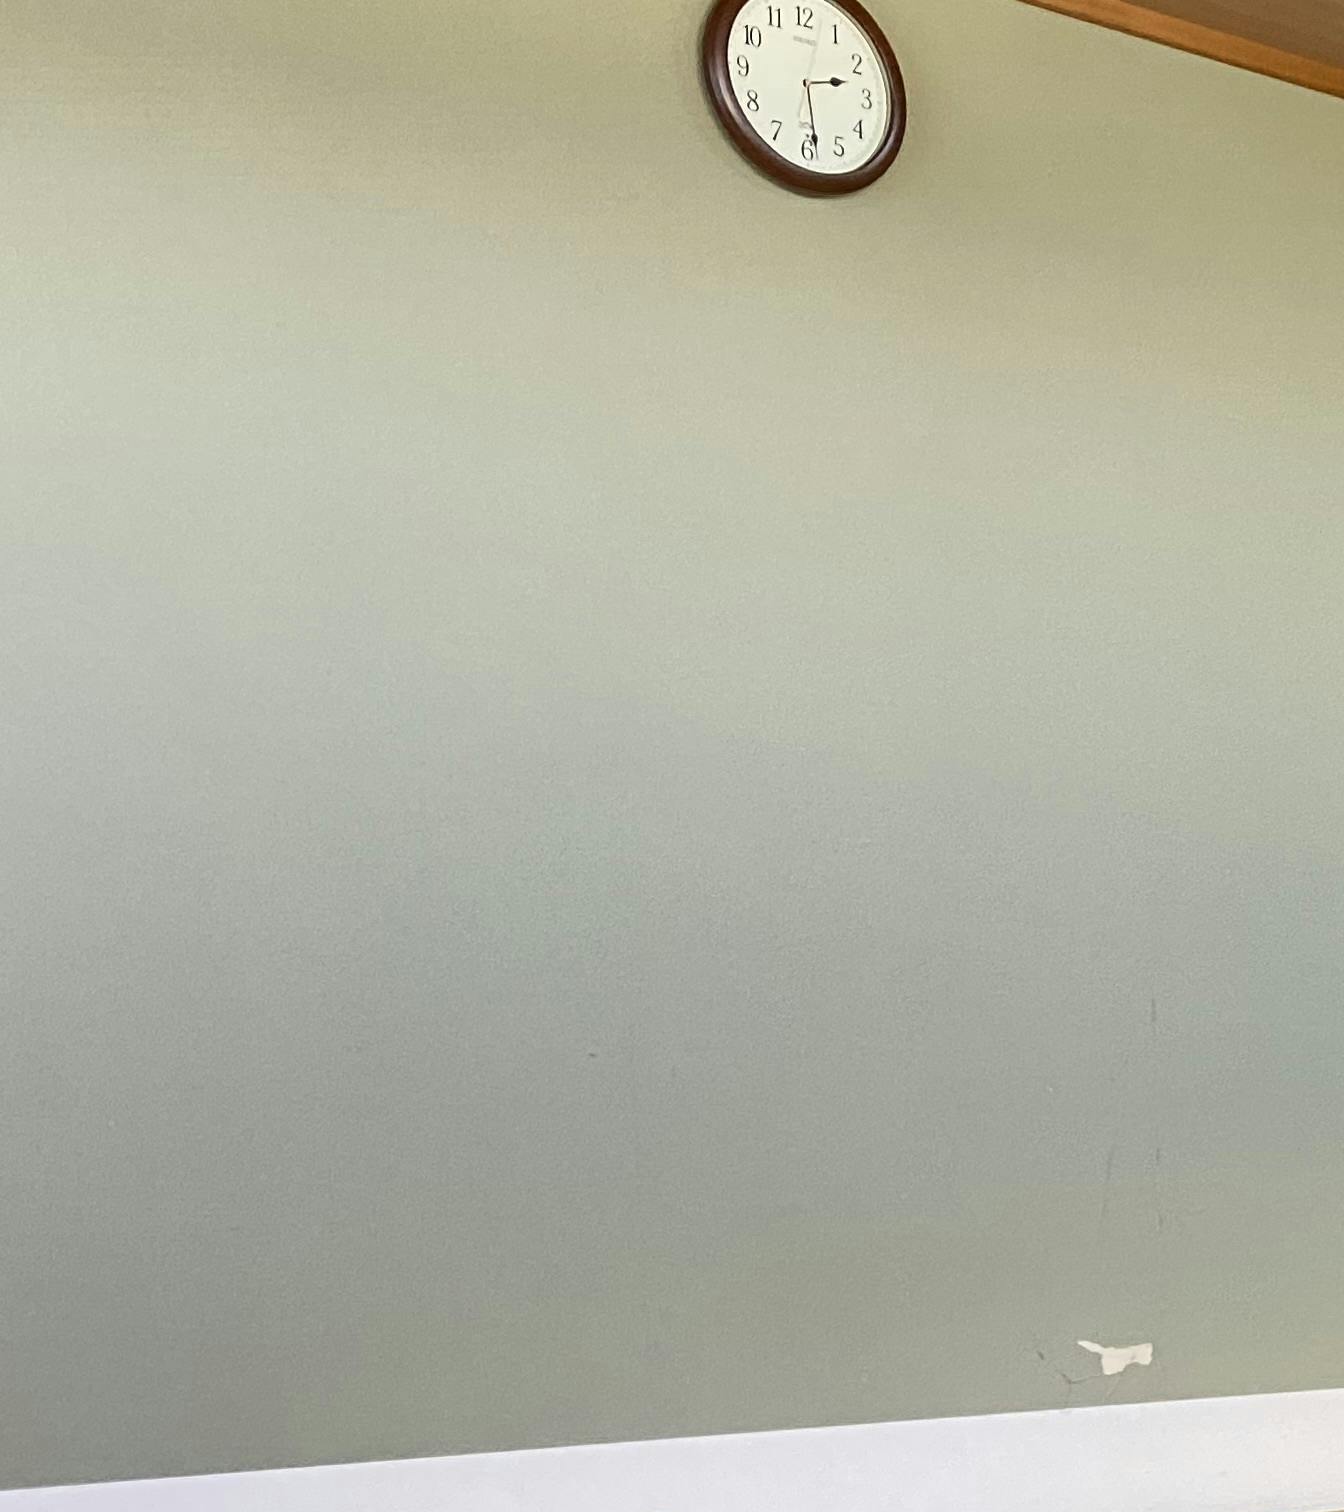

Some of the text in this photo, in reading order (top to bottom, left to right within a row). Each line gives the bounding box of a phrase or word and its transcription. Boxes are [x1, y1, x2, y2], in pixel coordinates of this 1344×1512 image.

[767, 5, 783, 29] 11
[796, 6, 814, 29] 12
[744, 24, 762, 48] 10
[832, 24, 839, 45] 1
[736, 55, 750, 77] 9
[851, 53, 863, 75] 2
[747, 89, 760, 112] 8
[861, 88, 873, 110] 3
[770, 120, 782, 142] 7
[853, 119, 864, 140] 4
[801, 138, 814, 161] 6
[833, 136, 845, 158] 5
